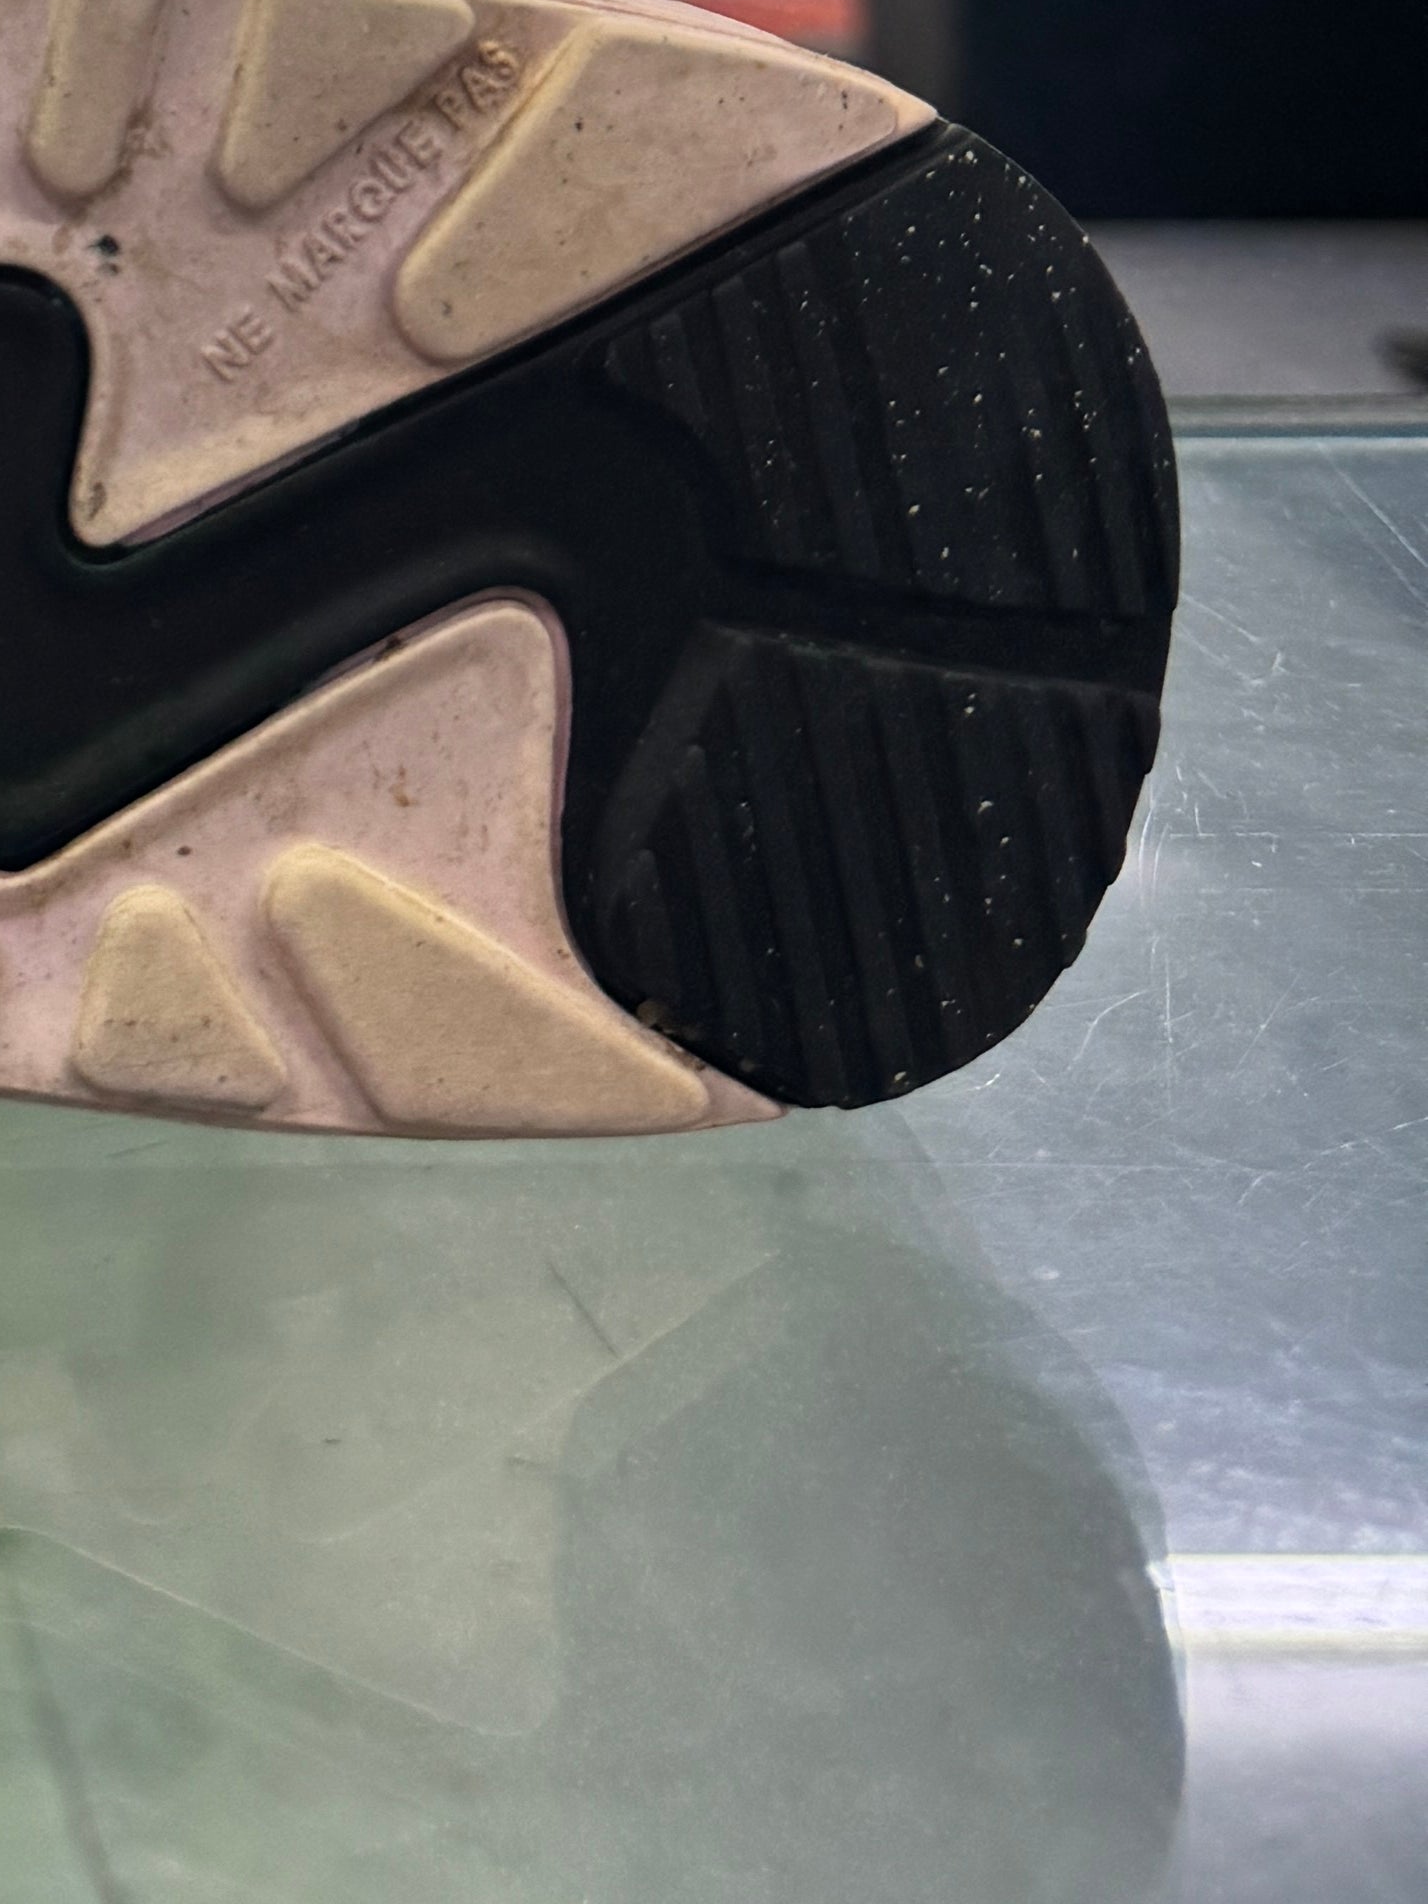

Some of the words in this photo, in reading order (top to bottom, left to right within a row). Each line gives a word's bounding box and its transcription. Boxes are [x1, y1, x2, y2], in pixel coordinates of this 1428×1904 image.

[199, 305, 276, 384] NE
[265, 119, 444, 313] MARQUE
[433, 38, 520, 133] PAS
